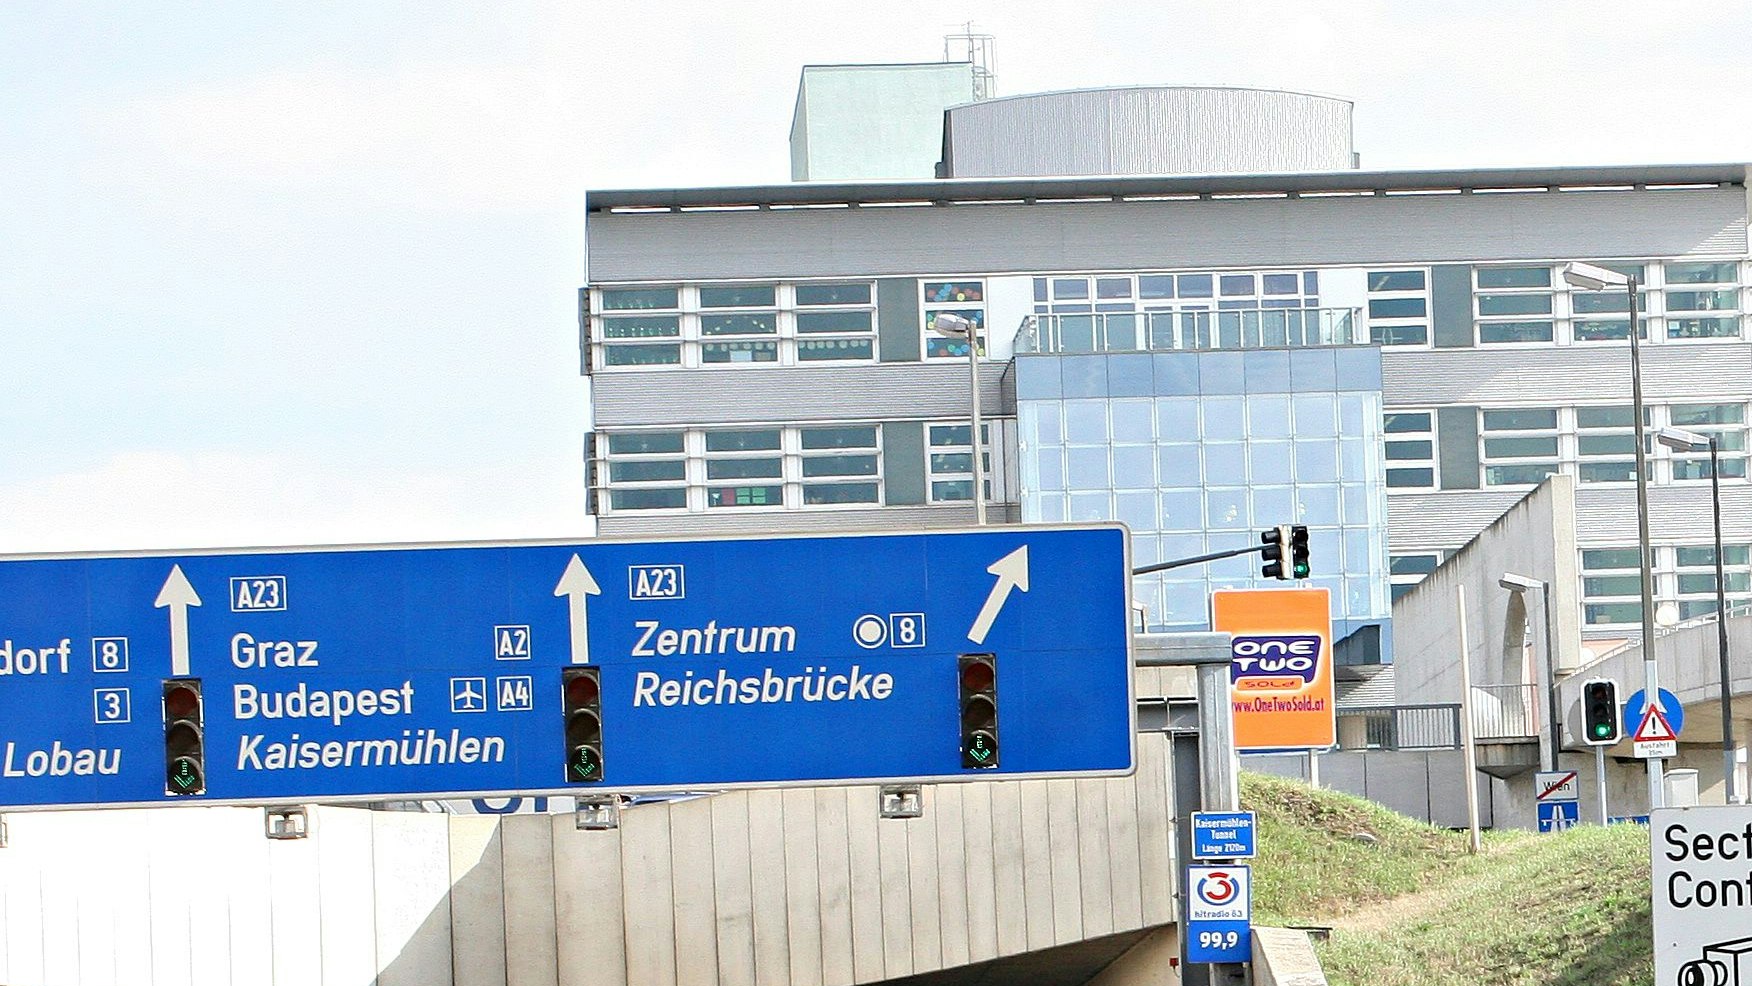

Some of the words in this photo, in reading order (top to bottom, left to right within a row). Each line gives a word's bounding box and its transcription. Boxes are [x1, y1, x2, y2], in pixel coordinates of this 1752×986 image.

[238, 580, 279, 608] A23
[637, 569, 676, 597] A23
[230, 633, 319, 668] Graz
[499, 630, 527, 656] A2
[632, 621, 796, 656] Zentrum
[900, 617, 916, 643] 8
[102, 641, 118, 668] 8
[1232, 657, 1313, 672] TWO
[632, 665, 894, 707] Reichsbrücke
[104, 692, 121, 719] 3
[233, 680, 414, 726] Budapest
[501, 680, 529, 707] A4
[1231, 696, 1324, 712] ww.OneTwoSold.at
[3, 741, 122, 777] Lobau
[237, 729, 505, 771] Kaisermühlen
[1211, 830, 1237, 839] Tunnel
[1200, 931, 1238, 949] 99,9
